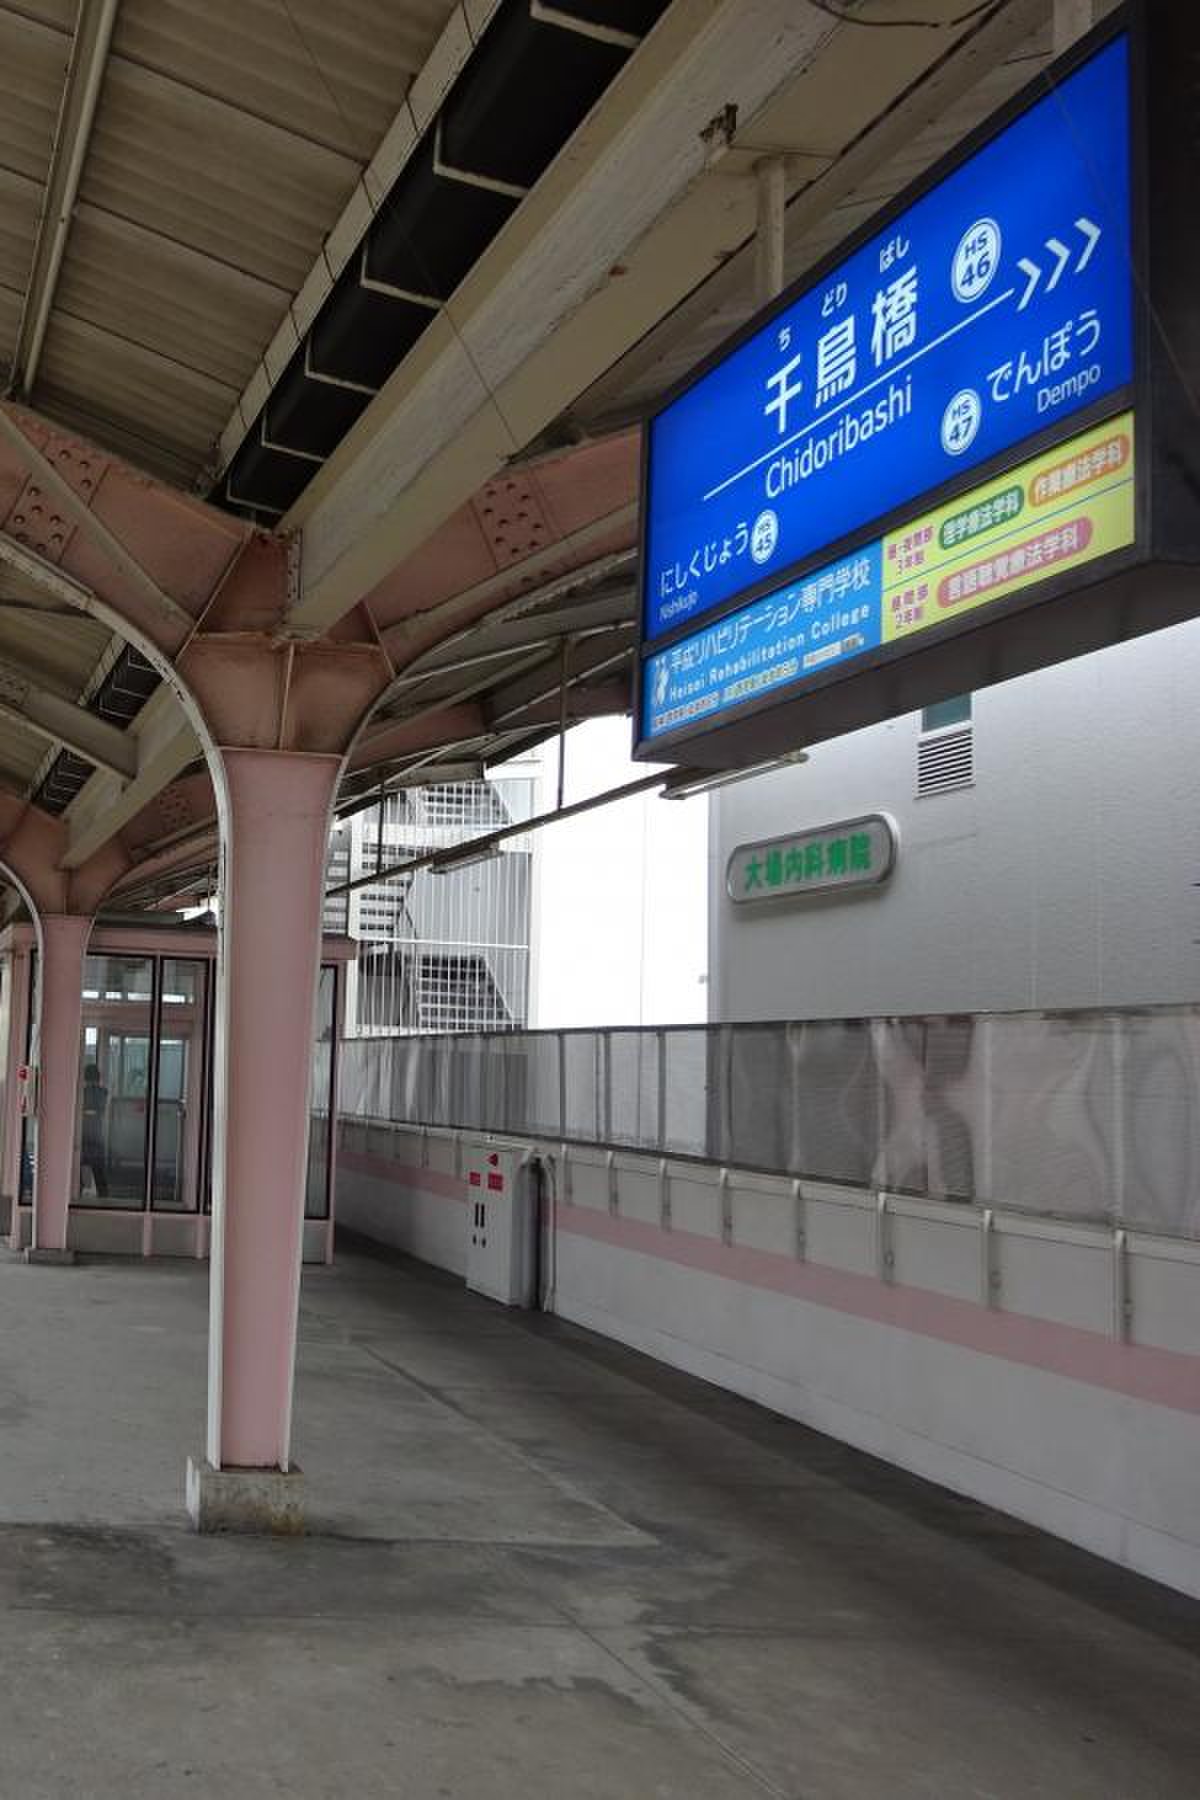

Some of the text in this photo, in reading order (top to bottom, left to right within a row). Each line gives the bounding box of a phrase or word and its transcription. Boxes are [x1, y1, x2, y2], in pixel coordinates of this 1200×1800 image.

[961, 253, 991, 288] 46
[964, 230, 989, 261] HS
[777, 235, 910, 352] ち どり ばし
[764, 265, 918, 434] 千鳥橋
[986, 309, 1101, 402] でんぽう
[951, 401, 971, 419] HS
[1037, 364, 1101, 413] Dempo
[765, 374, 913, 499] Chidoribashi
[949, 415, 972, 442] 47
[660, 521, 749, 598] にしくじょう
[811, 604, 870, 641] College
[745, 832, 871, 893] 大内科病院
